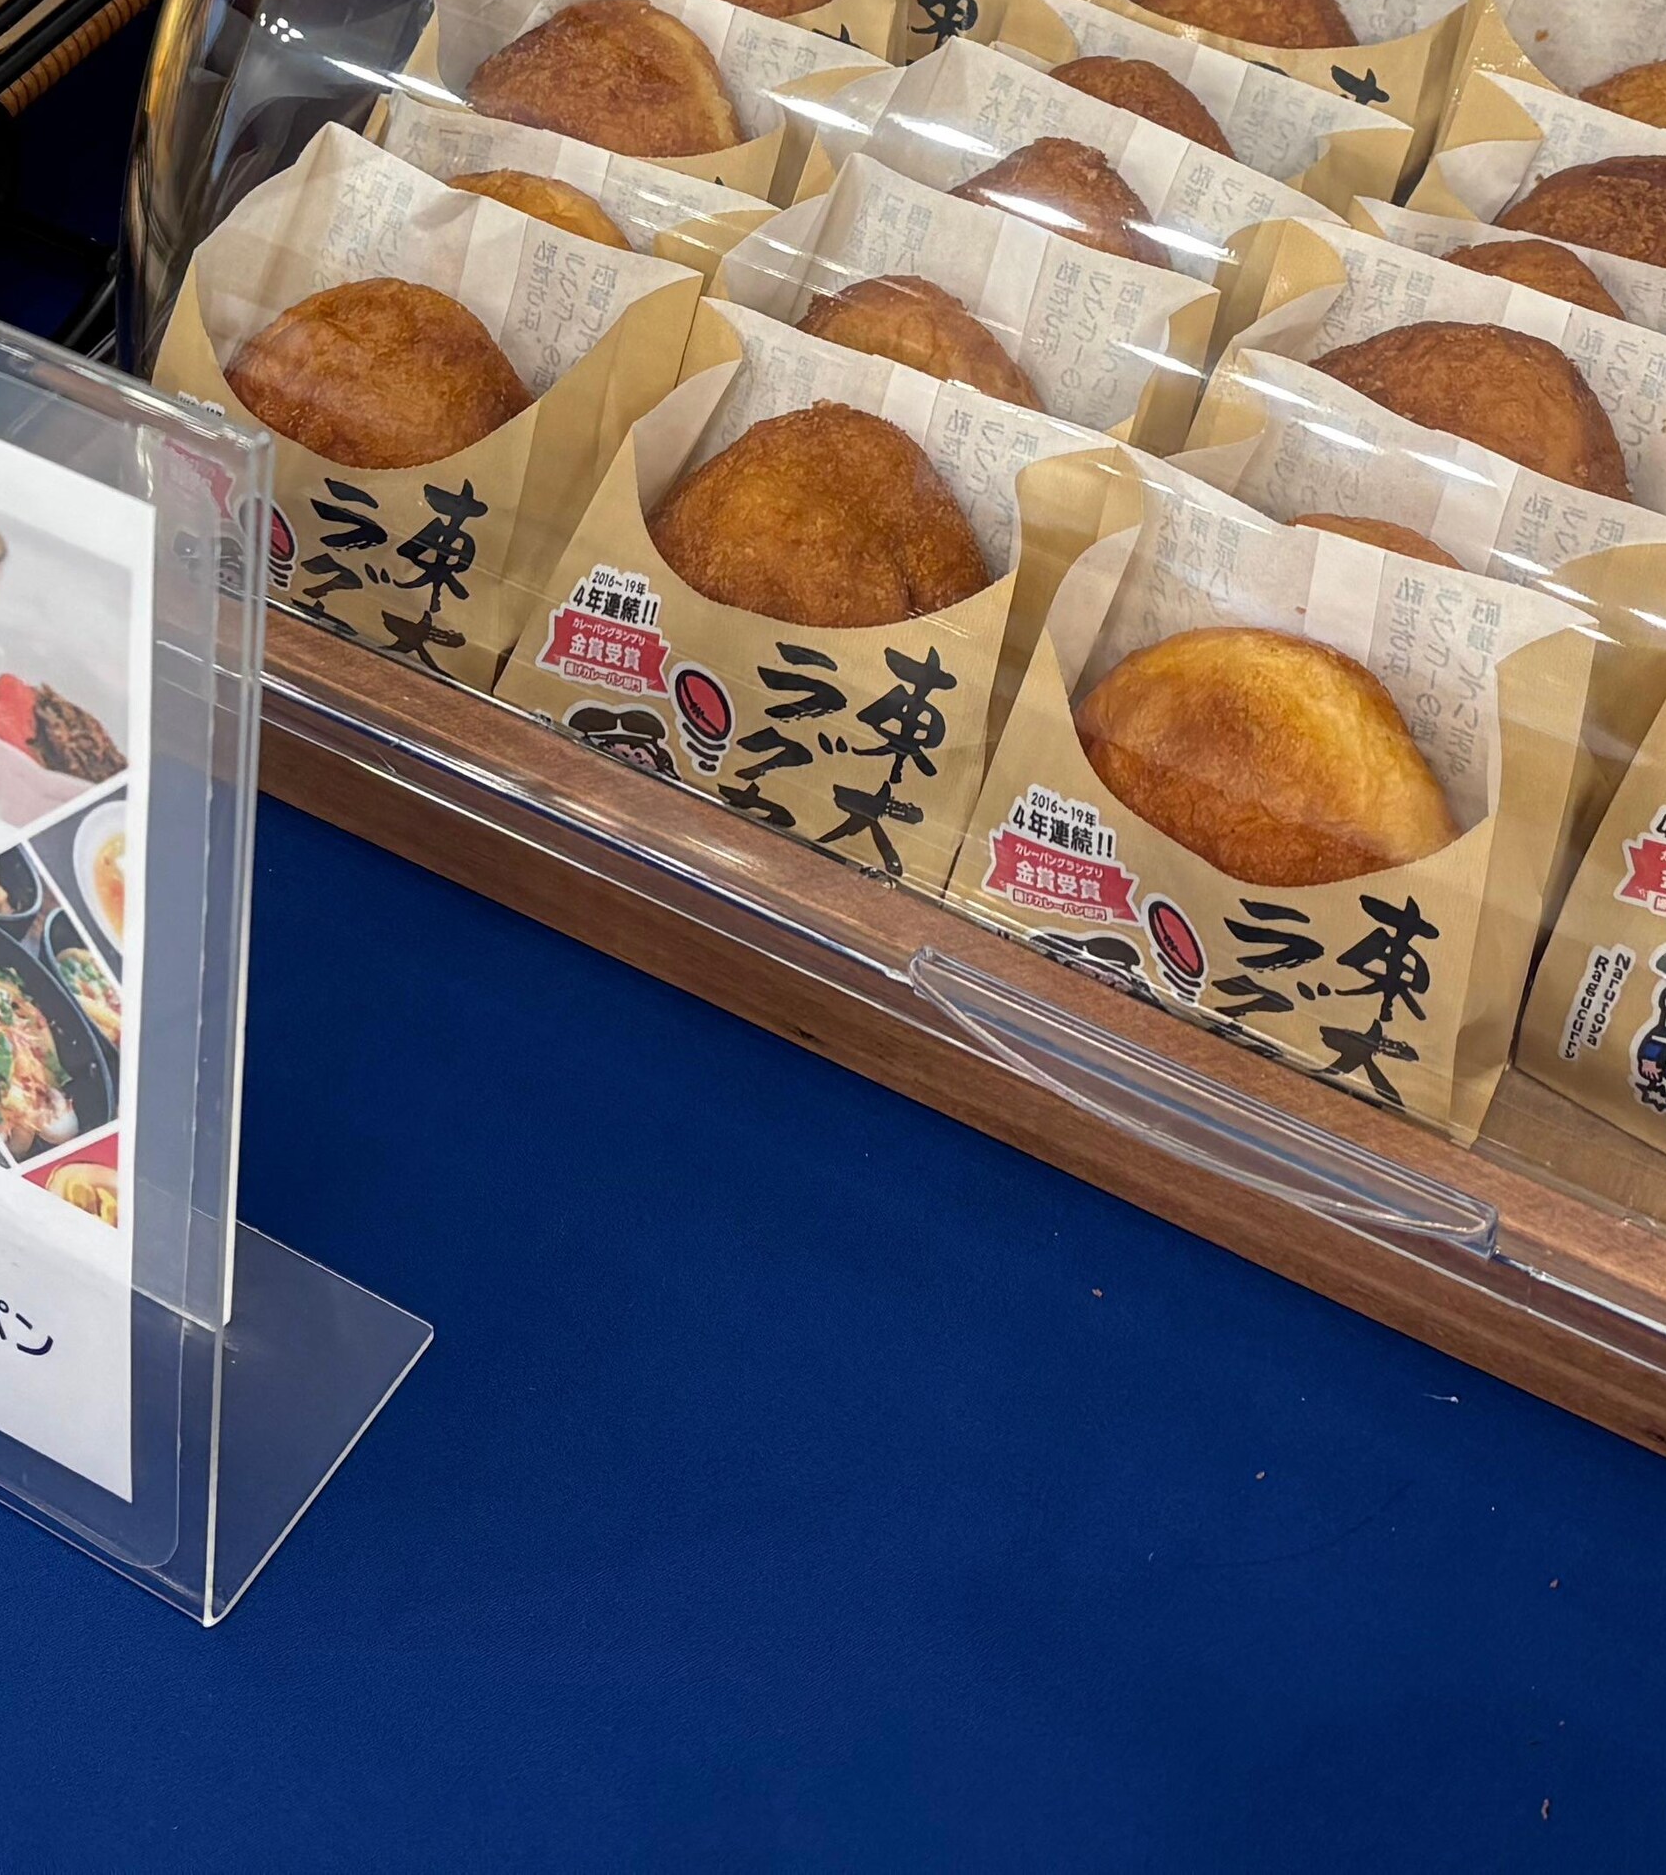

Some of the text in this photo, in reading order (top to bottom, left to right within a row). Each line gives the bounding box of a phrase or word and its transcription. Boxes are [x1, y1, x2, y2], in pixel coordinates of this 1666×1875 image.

[569, 633, 642, 672] 金賞受賞
[1016, 860, 1102, 903] 金賞受賞
[1565, 955, 1609, 1059] Ragucurry
[1587, 952, 1631, 1046] Narutoya
